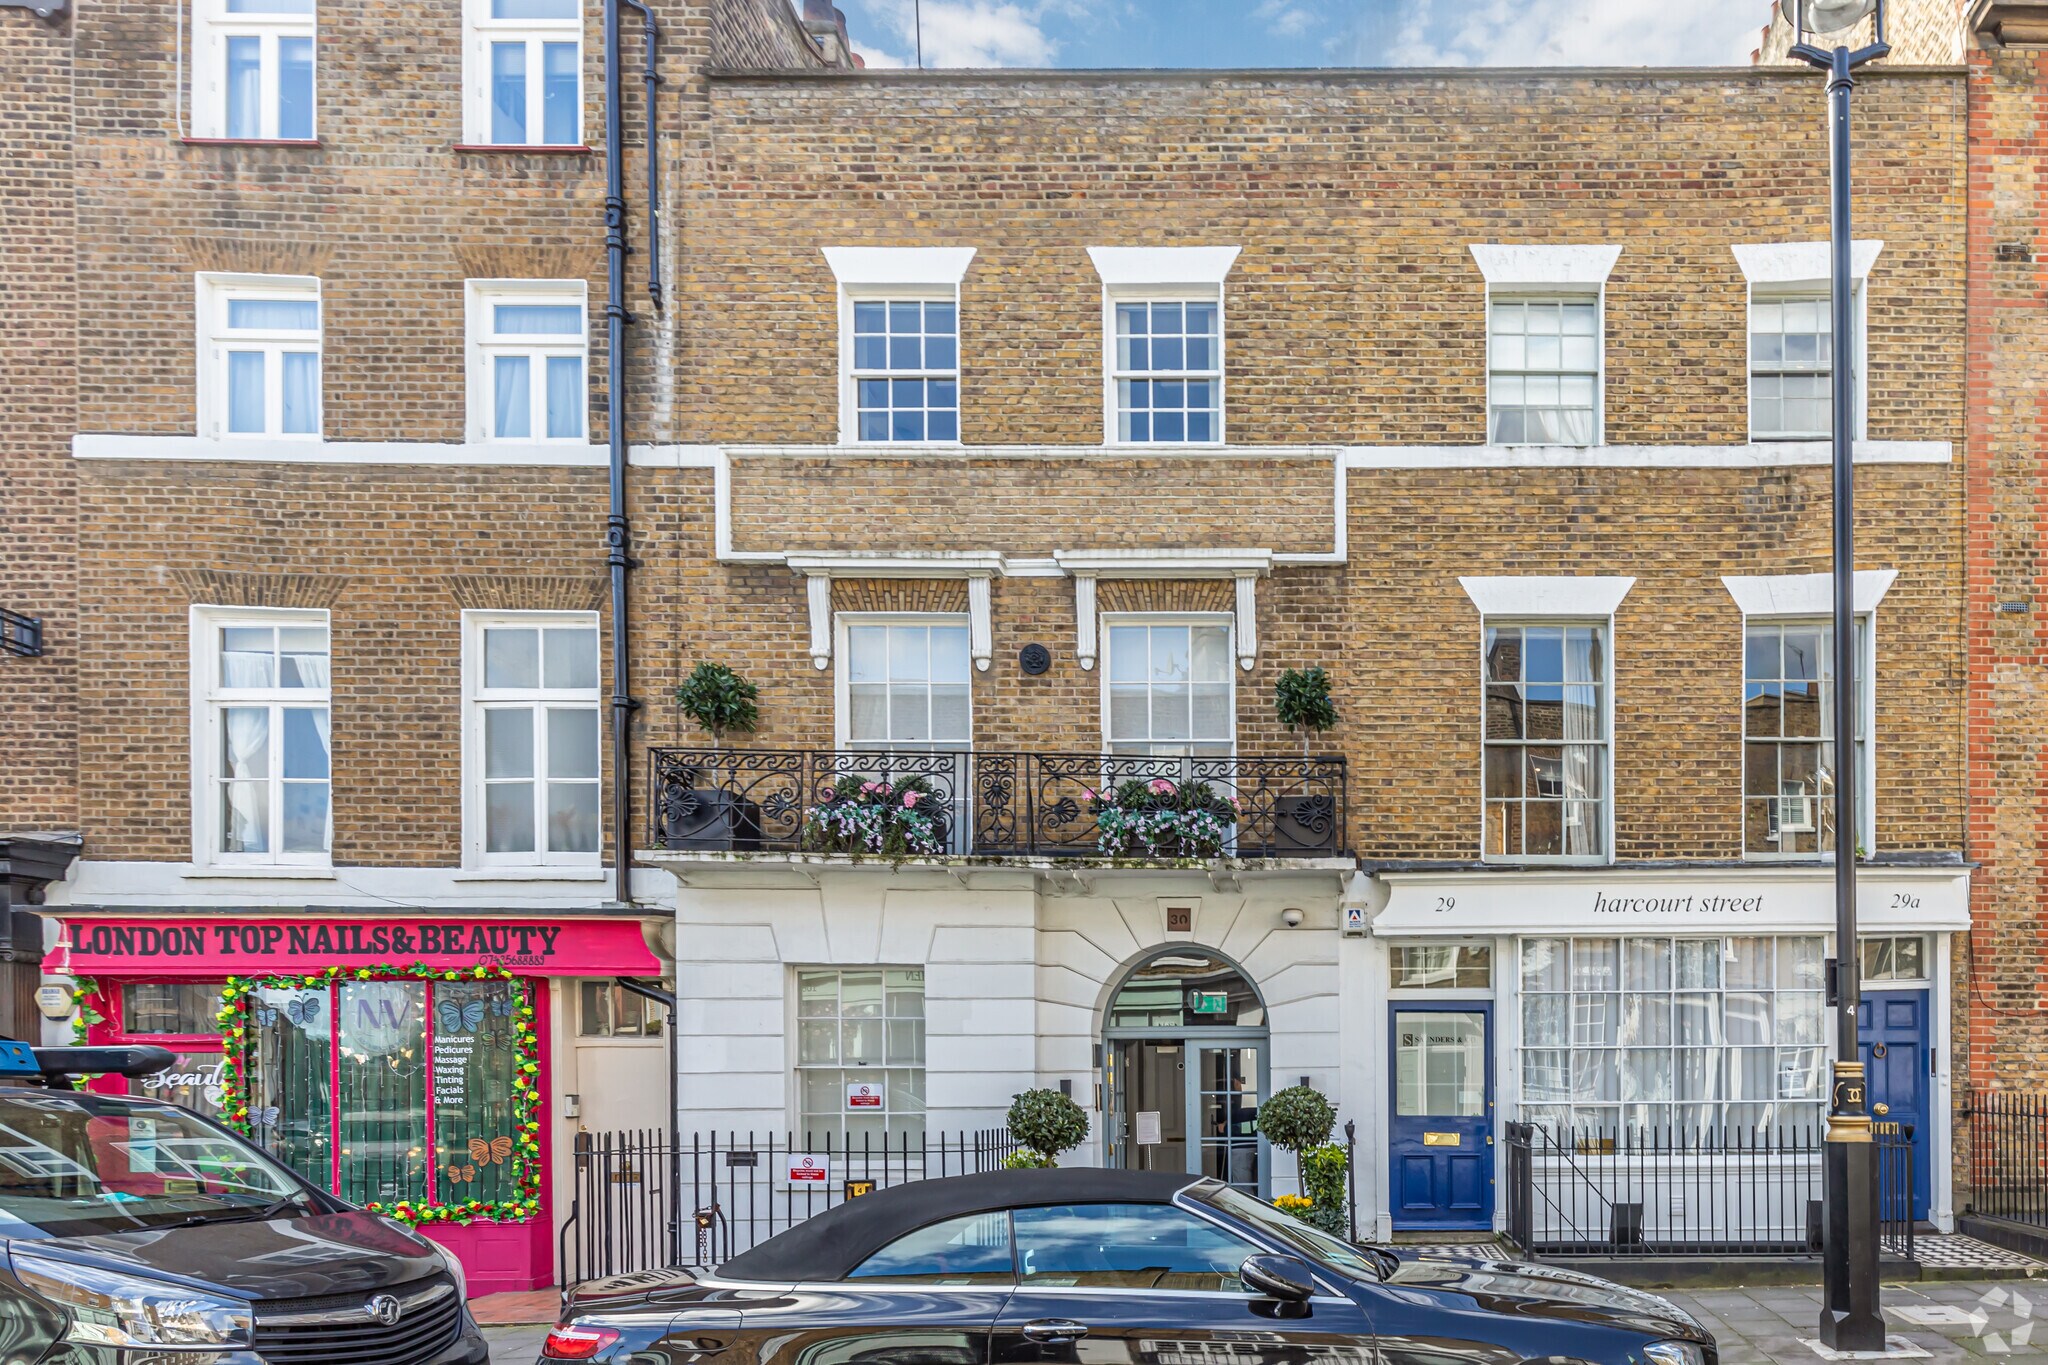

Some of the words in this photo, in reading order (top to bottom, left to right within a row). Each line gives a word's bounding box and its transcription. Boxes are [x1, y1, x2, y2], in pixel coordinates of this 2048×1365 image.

[1435, 897, 1456, 912] 29
[1594, 892, 1693, 912] harcourt
[1700, 895, 1763, 912] street
[1890, 893, 1920, 909] 29a
[1170, 914, 1188, 925] 30
[69, 924, 206, 956] LONDON
[214, 925, 283, 955] TOP
[1847, 1005, 1855, 1015] 4
[434, 1046, 473, 1054] Pedicures
[434, 1056, 468, 1065] Massage
[435, 1066, 464, 1075] Waxing
[435, 1076, 464, 1085] Tinting
[436, 1086, 464, 1094] Facials
[434, 1096, 442, 1104] &
[443, 1096, 464, 1104] More
